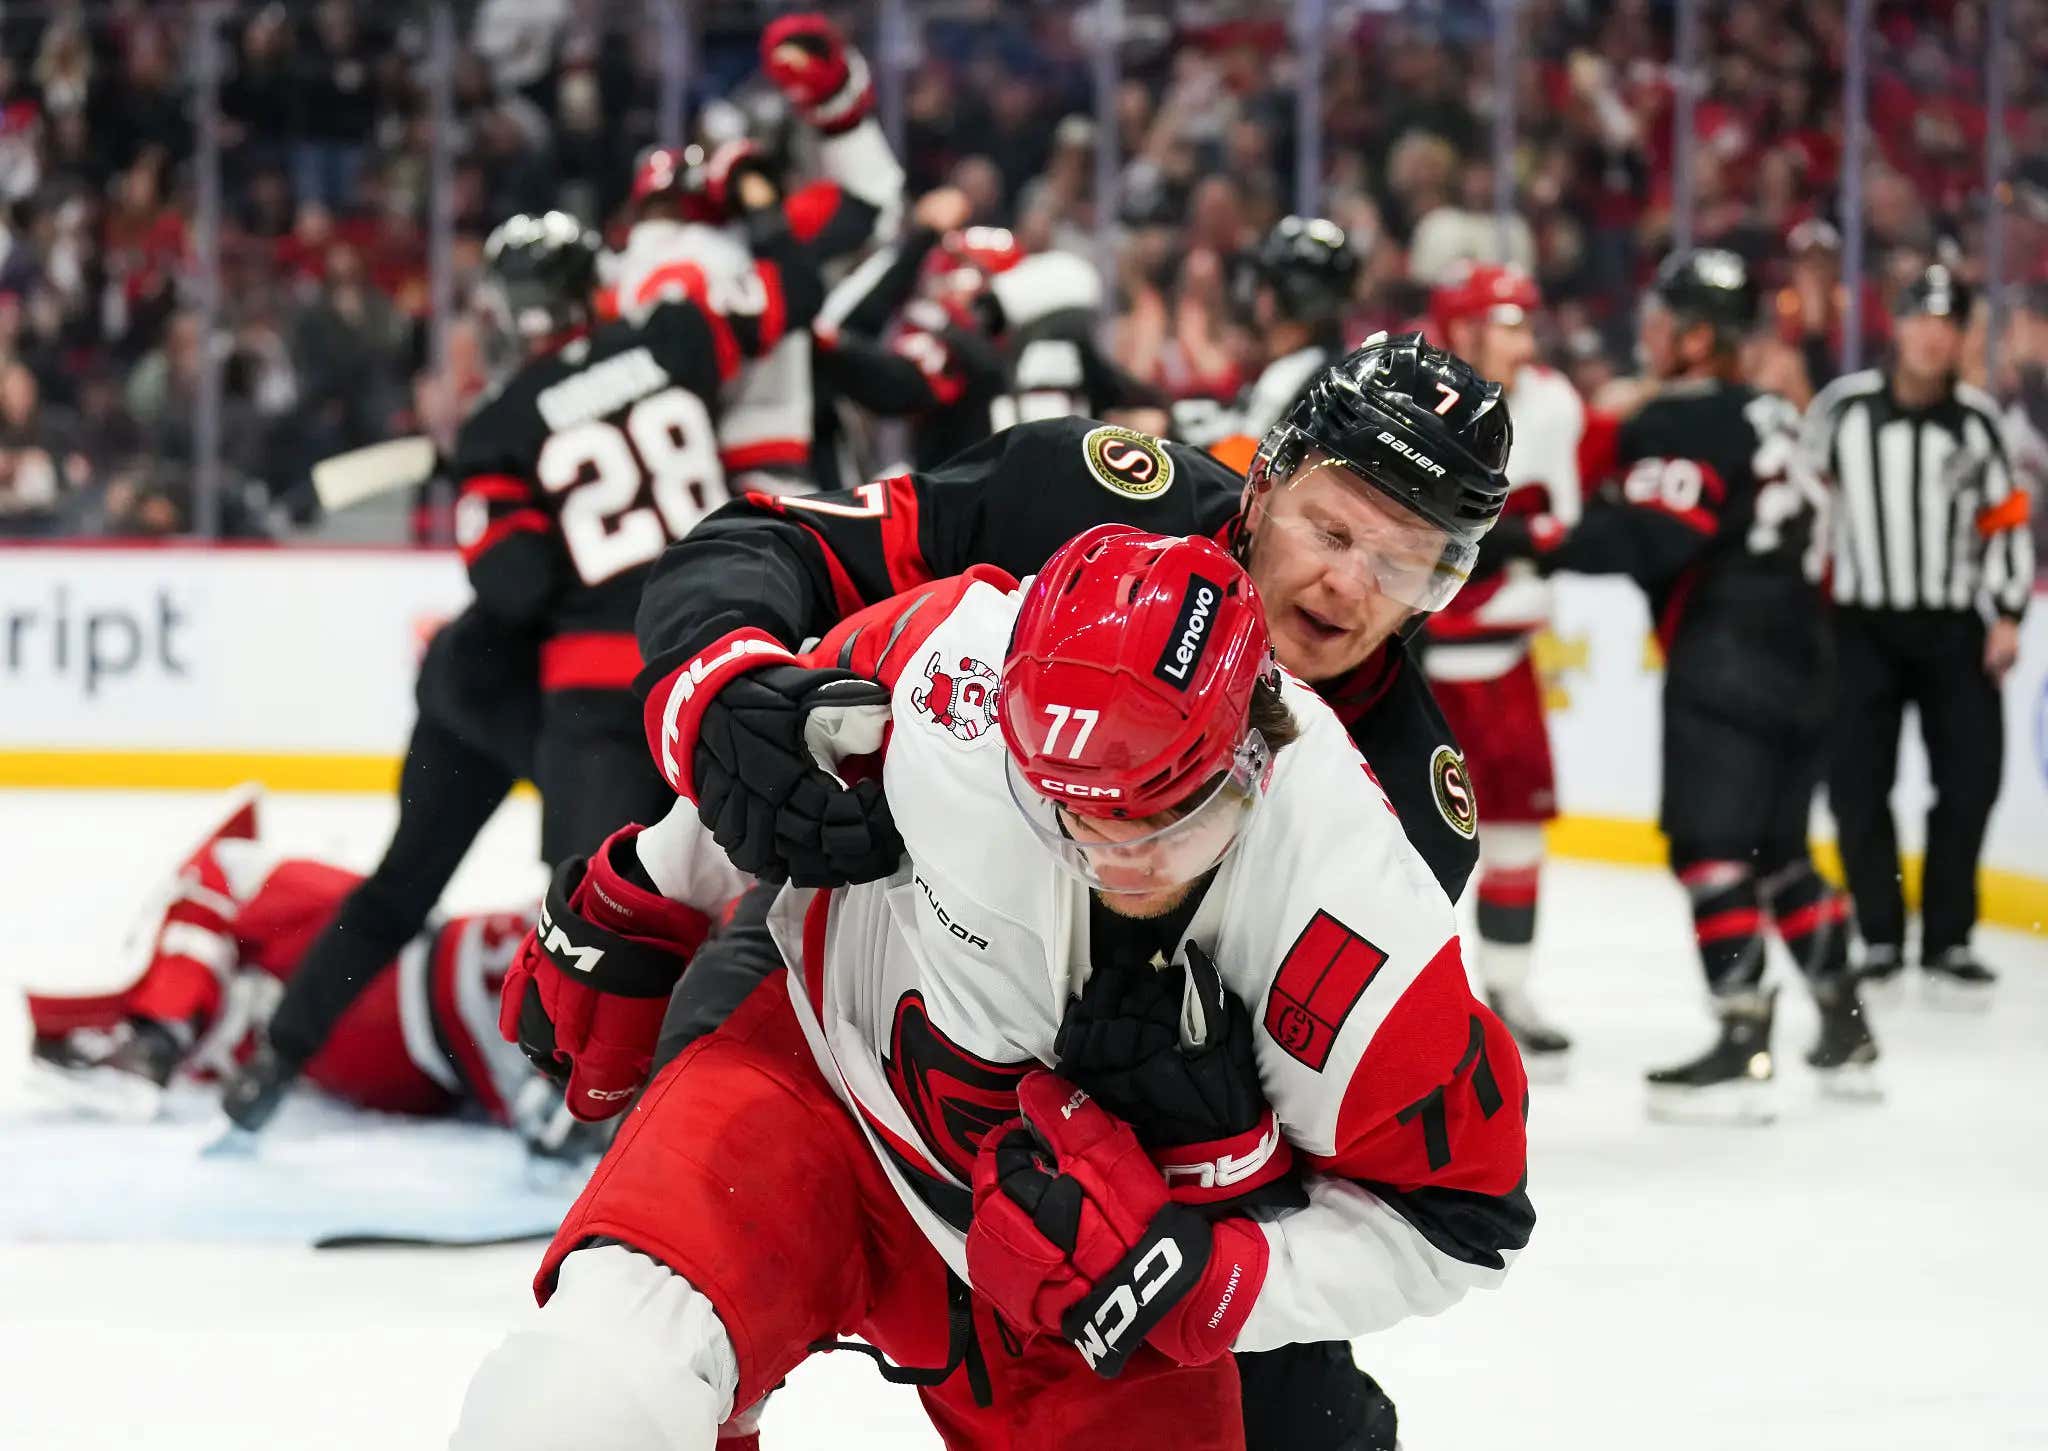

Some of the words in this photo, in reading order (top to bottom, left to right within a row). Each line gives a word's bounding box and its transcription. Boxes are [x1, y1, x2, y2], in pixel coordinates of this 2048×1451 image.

[1434, 381, 1461, 416] 7
[537, 386, 734, 588] 28
[1376, 431, 1447, 479] BAUER
[5, 584, 193, 700] ript
[1163, 587, 1214, 680] Lenovo
[963, 682, 987, 708] C
[1041, 703, 1100, 760] 77
[1041, 778, 1121, 798] CCM
[538, 898, 605, 973] CM
[1060, 1089, 1090, 1121] CM
[1396, 1013, 1504, 1172] 77
[1074, 1237, 1183, 1371] CCM
[1208, 1263, 1243, 1329] JANKOWSKI
